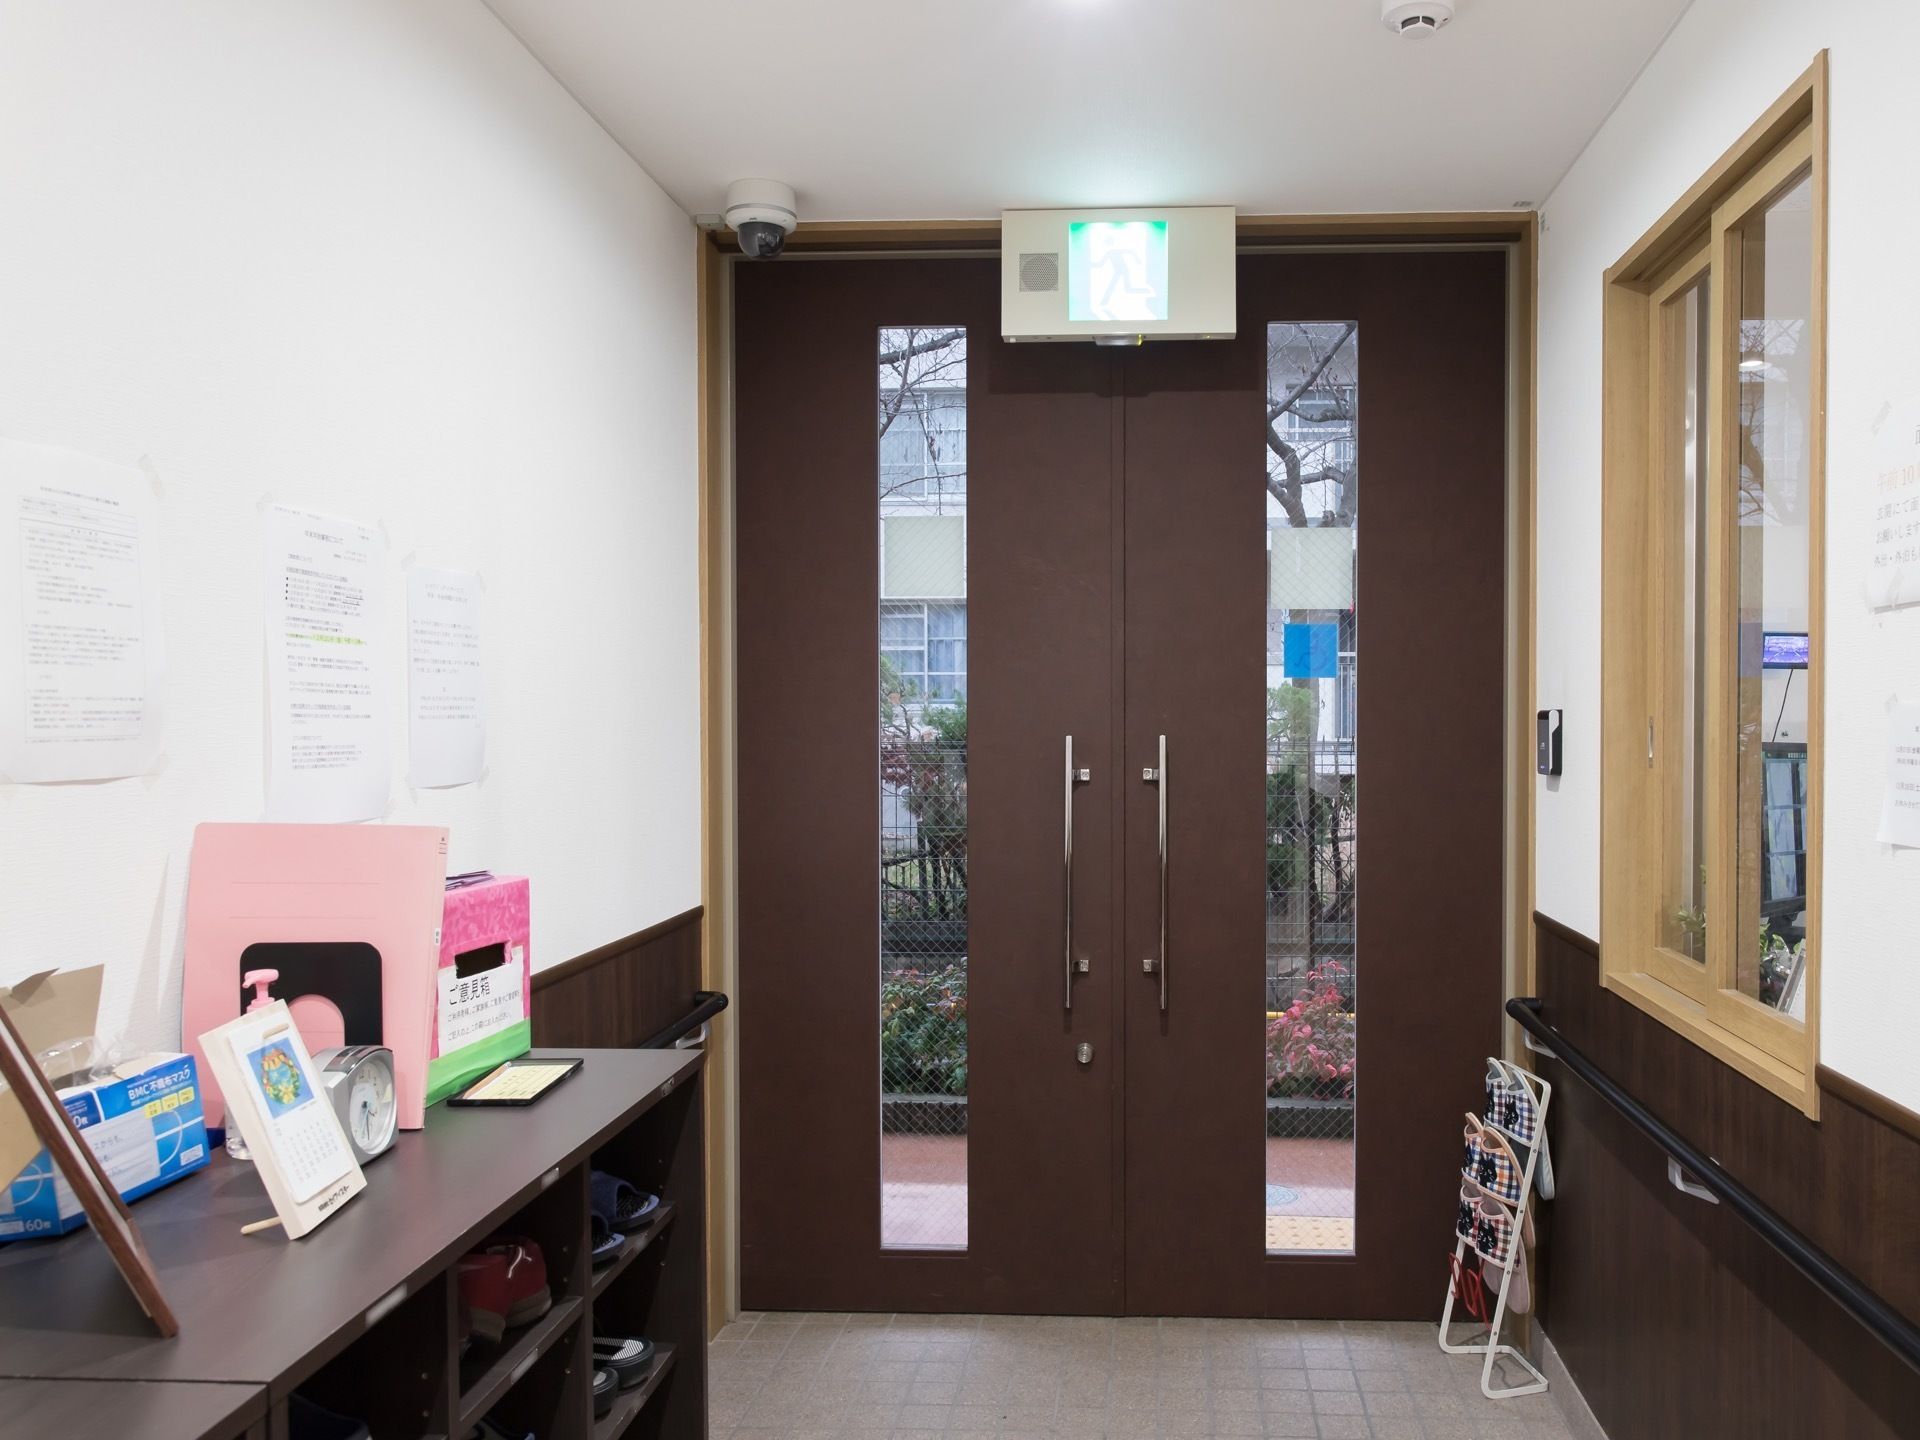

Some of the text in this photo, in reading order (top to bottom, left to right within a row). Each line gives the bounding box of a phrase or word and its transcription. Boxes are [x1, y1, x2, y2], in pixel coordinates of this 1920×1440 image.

[1877, 463, 1920, 494] 午前10
[449, 975, 490, 1005] ご意見箱
